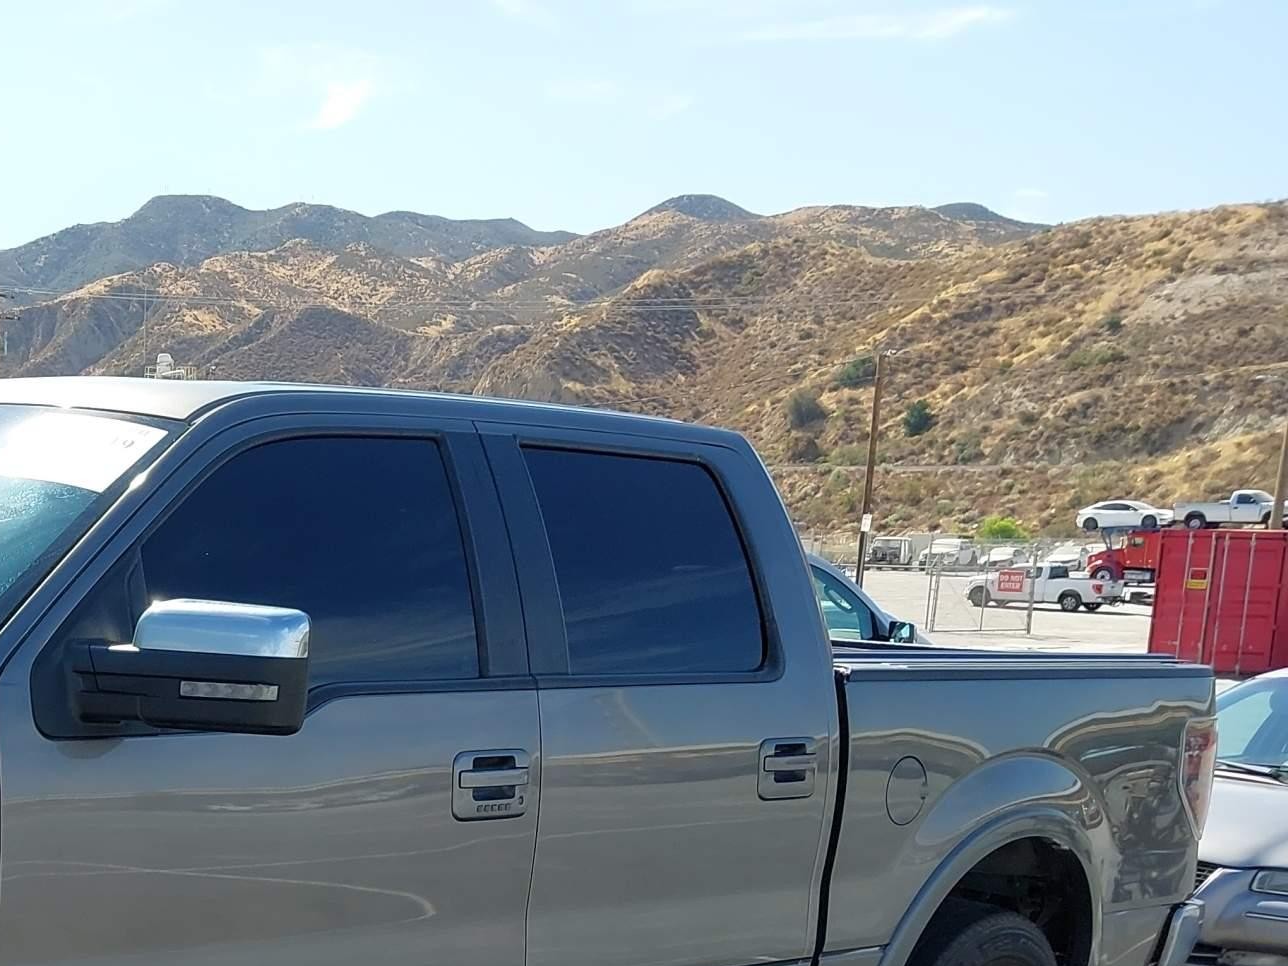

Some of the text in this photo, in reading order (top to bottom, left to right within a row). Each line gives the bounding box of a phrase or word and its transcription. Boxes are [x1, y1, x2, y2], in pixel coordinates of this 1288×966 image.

[999, 574, 1023, 583] DO NOT
[1000, 582, 1021, 590] ENTER
